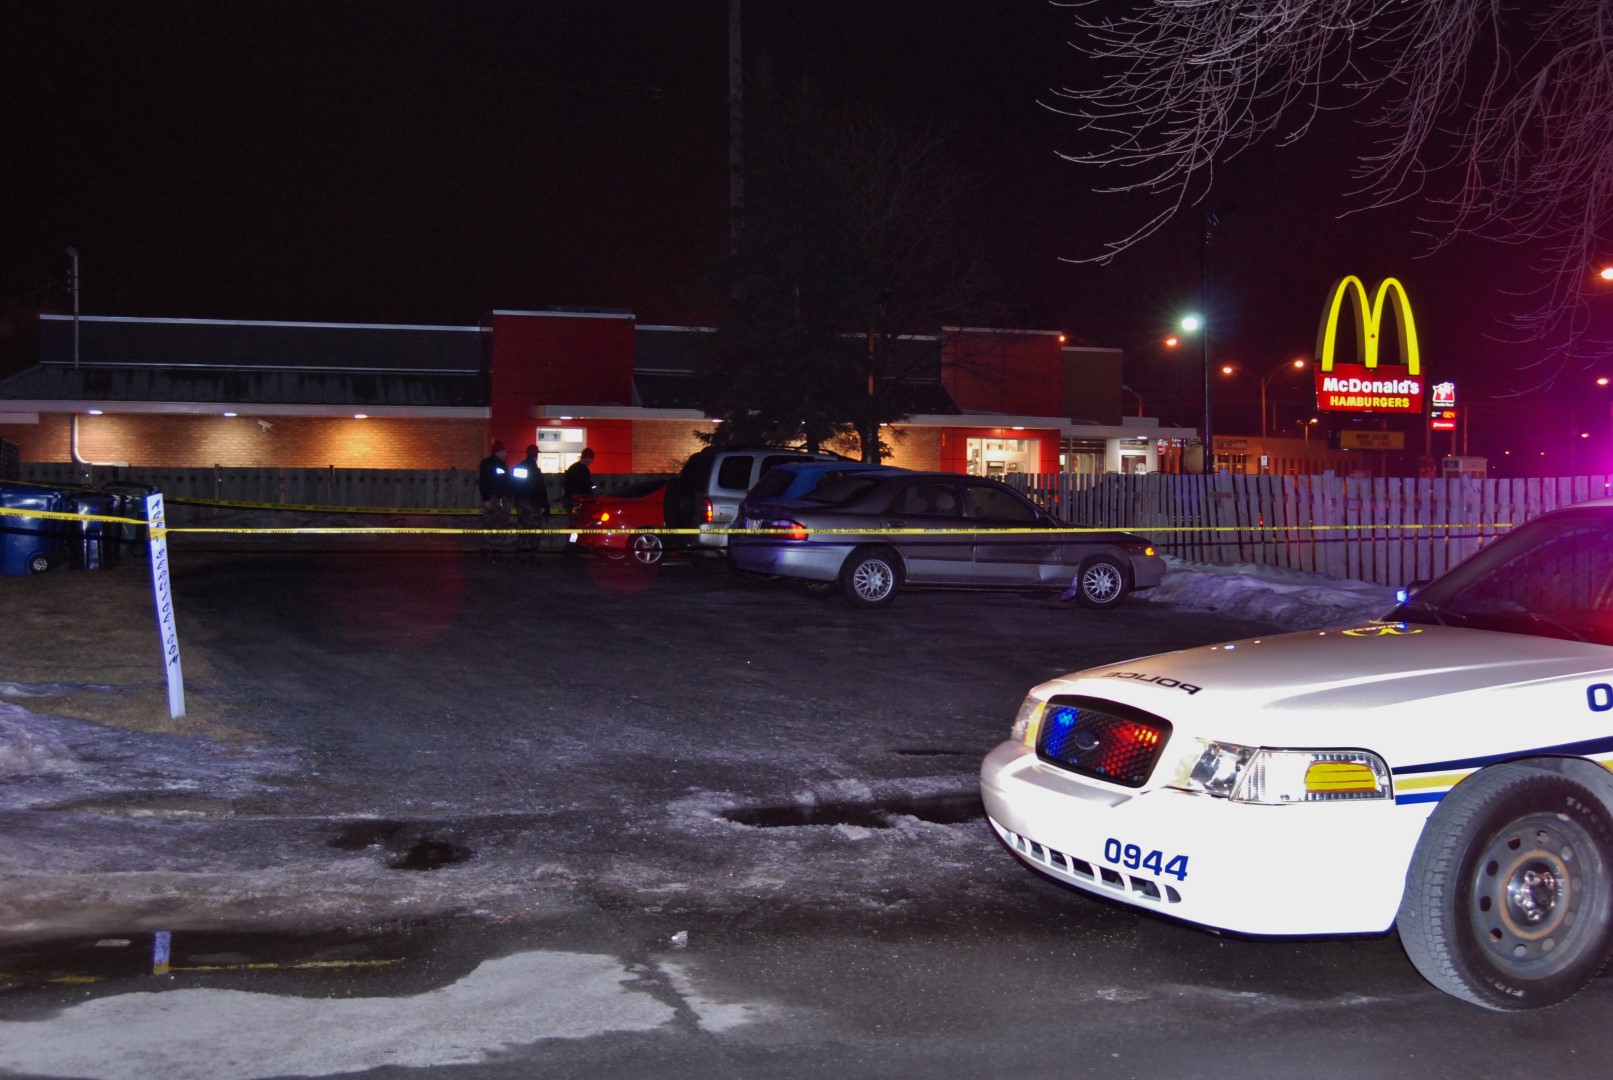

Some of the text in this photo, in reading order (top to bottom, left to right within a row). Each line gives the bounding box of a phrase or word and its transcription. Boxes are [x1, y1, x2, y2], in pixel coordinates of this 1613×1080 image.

[1322, 377, 1420, 395] McDonald's
[1329, 395, 1410, 408] HAMBURGERS
[1101, 671, 1203, 695] POLICE
[1104, 837, 1189, 882] 0944
